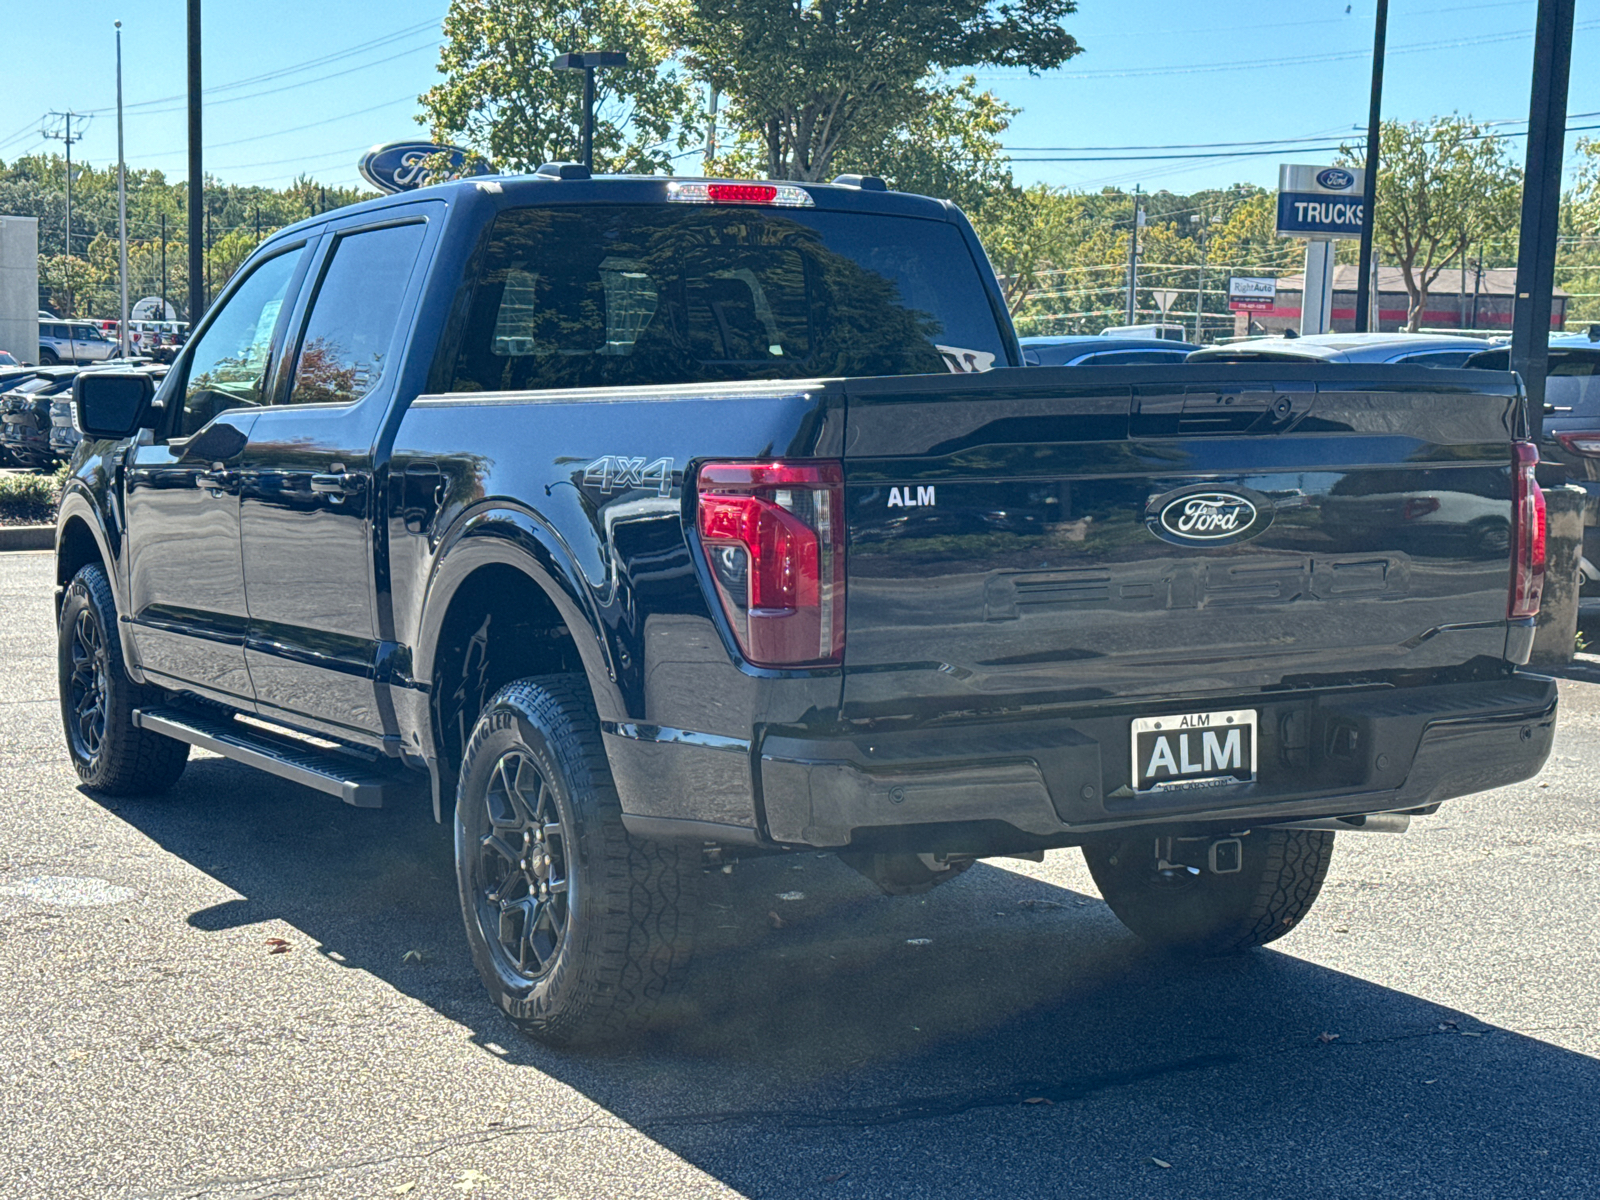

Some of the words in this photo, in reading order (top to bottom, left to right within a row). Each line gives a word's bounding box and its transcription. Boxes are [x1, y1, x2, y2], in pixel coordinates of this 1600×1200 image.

[1326, 172, 1349, 186] Ford
[1294, 202, 1364, 226] TRUCKS
[887, 485, 936, 508] ALM
[1178, 499, 1240, 531] Ford
[1180, 713, 1210, 728] ALM
[1145, 728, 1242, 778] ALM
